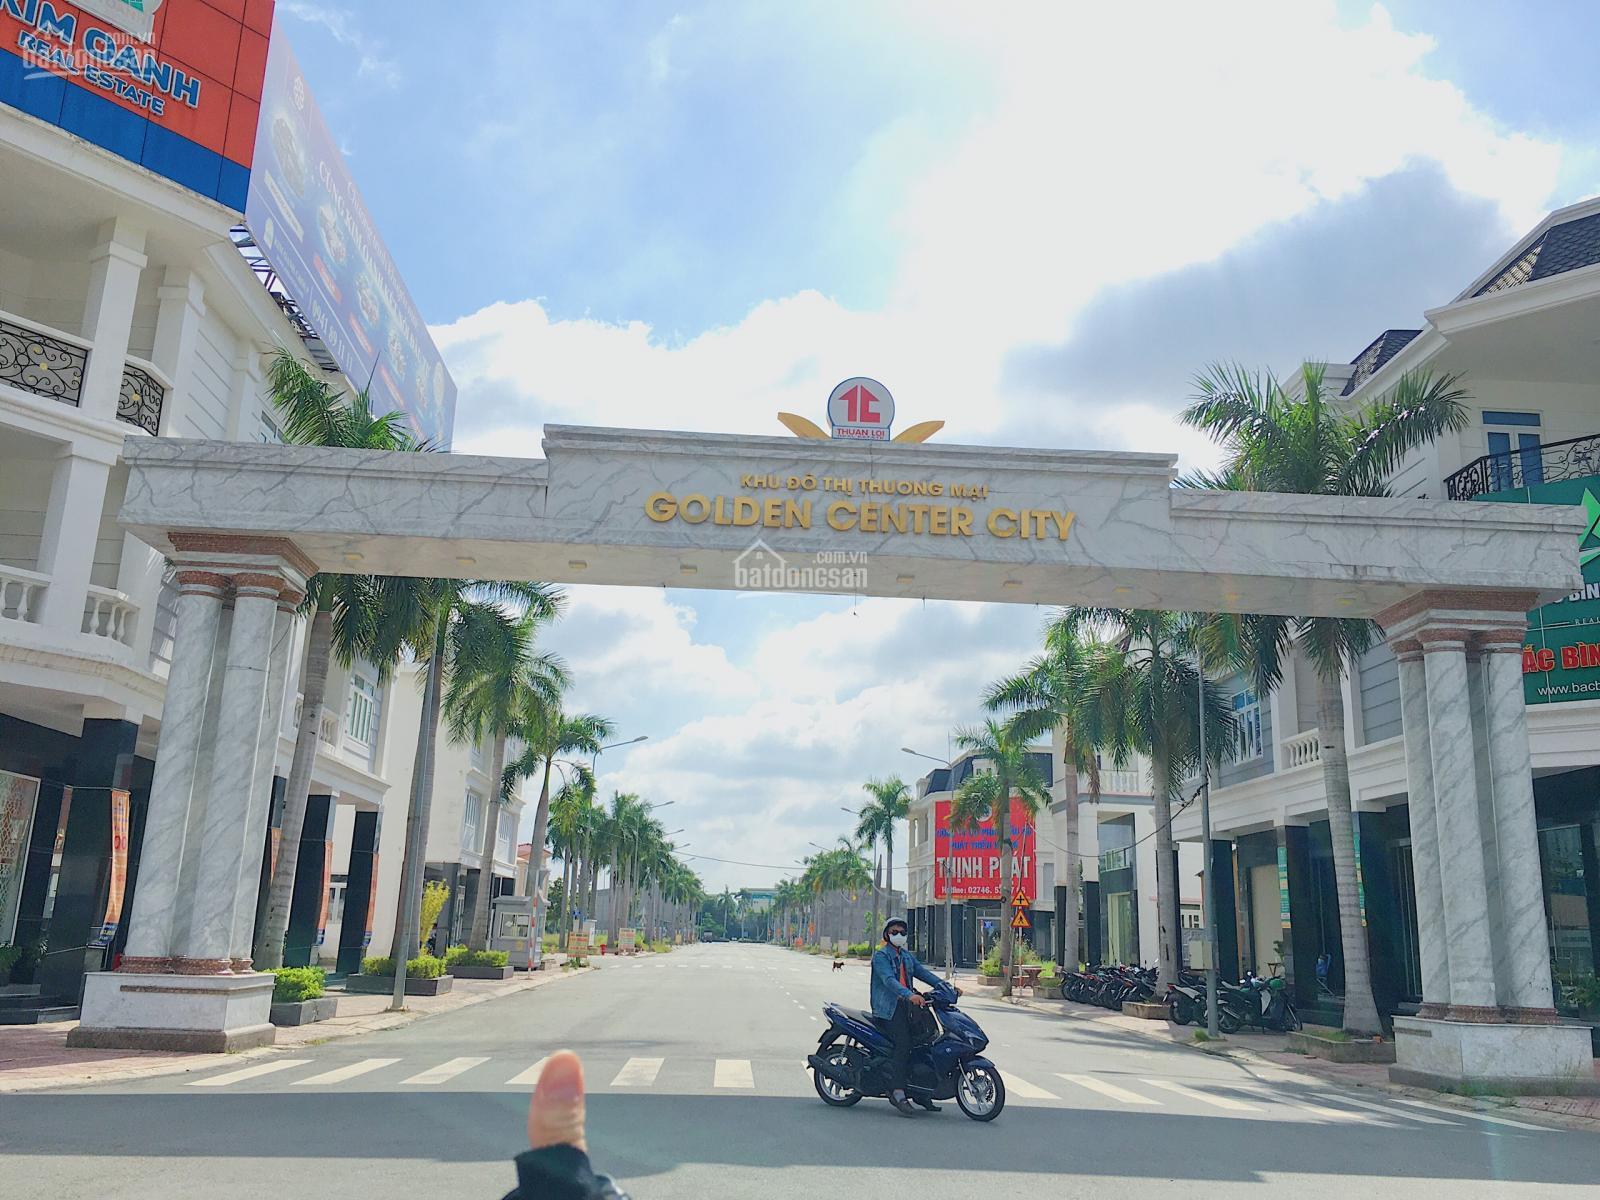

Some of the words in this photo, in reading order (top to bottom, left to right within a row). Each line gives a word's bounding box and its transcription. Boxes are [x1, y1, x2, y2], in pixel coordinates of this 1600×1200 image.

[18, 30, 80, 76] REAL
[84, 64, 165, 116] ESTATE
[362, 243, 383, 289] OANH
[740, 473, 781, 489] KHU
[823, 476, 852, 496] THỊ
[950, 482, 989, 502] MẠI
[645, 491, 812, 529] GOLDEN
[826, 500, 975, 537] CENTER
[987, 507, 1076, 540] CITY
[937, 857, 983, 883] THỊNH
[990, 851, 1031, 878] PÁT
